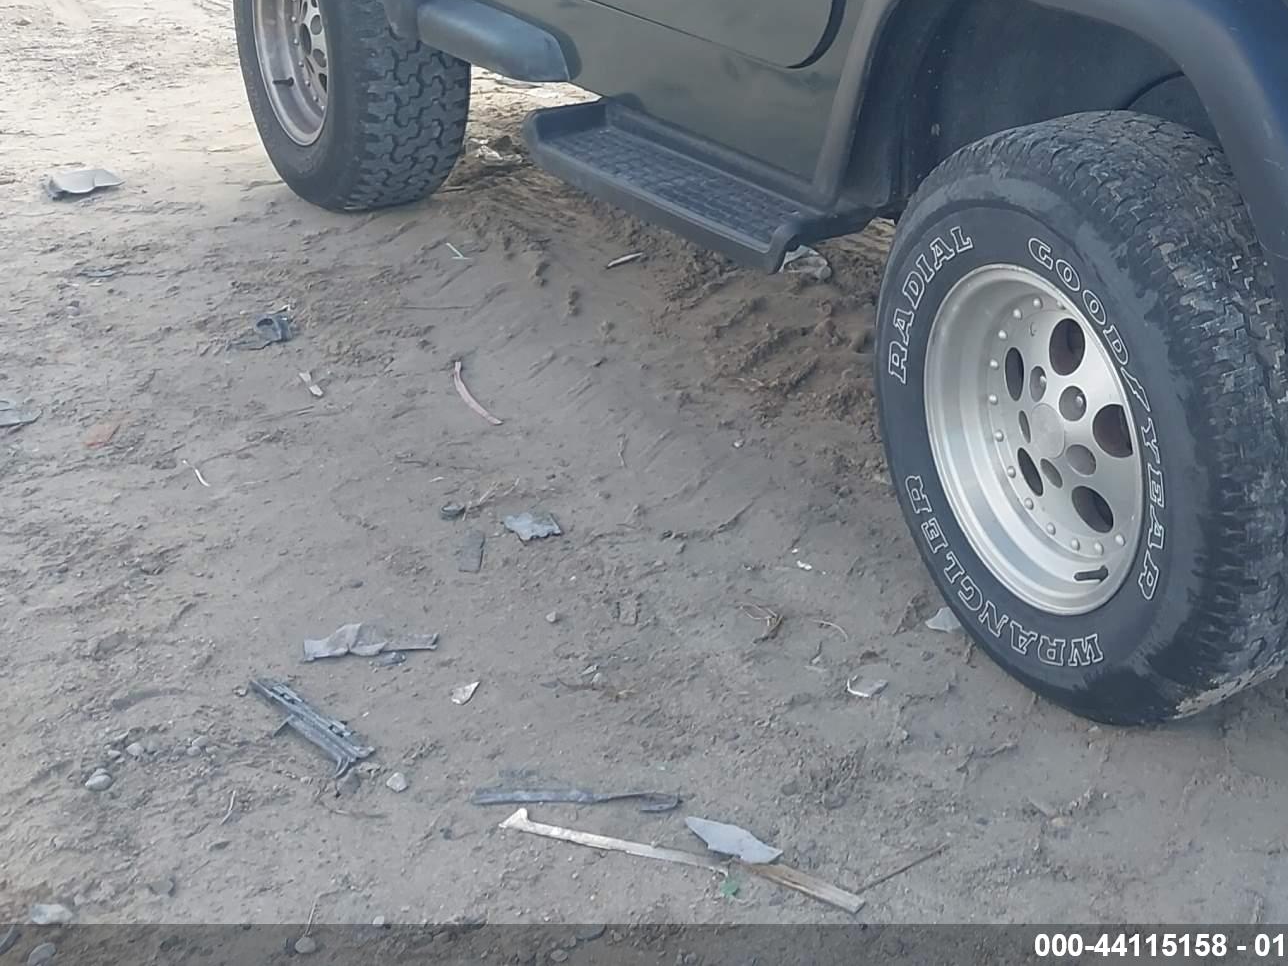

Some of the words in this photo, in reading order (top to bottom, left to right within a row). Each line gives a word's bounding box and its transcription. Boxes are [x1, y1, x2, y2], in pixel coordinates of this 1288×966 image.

[888, 226, 973, 384] RADIAL
[1028, 238, 1165, 601] GOODYEAR
[905, 475, 1104, 667] WRANGLER
